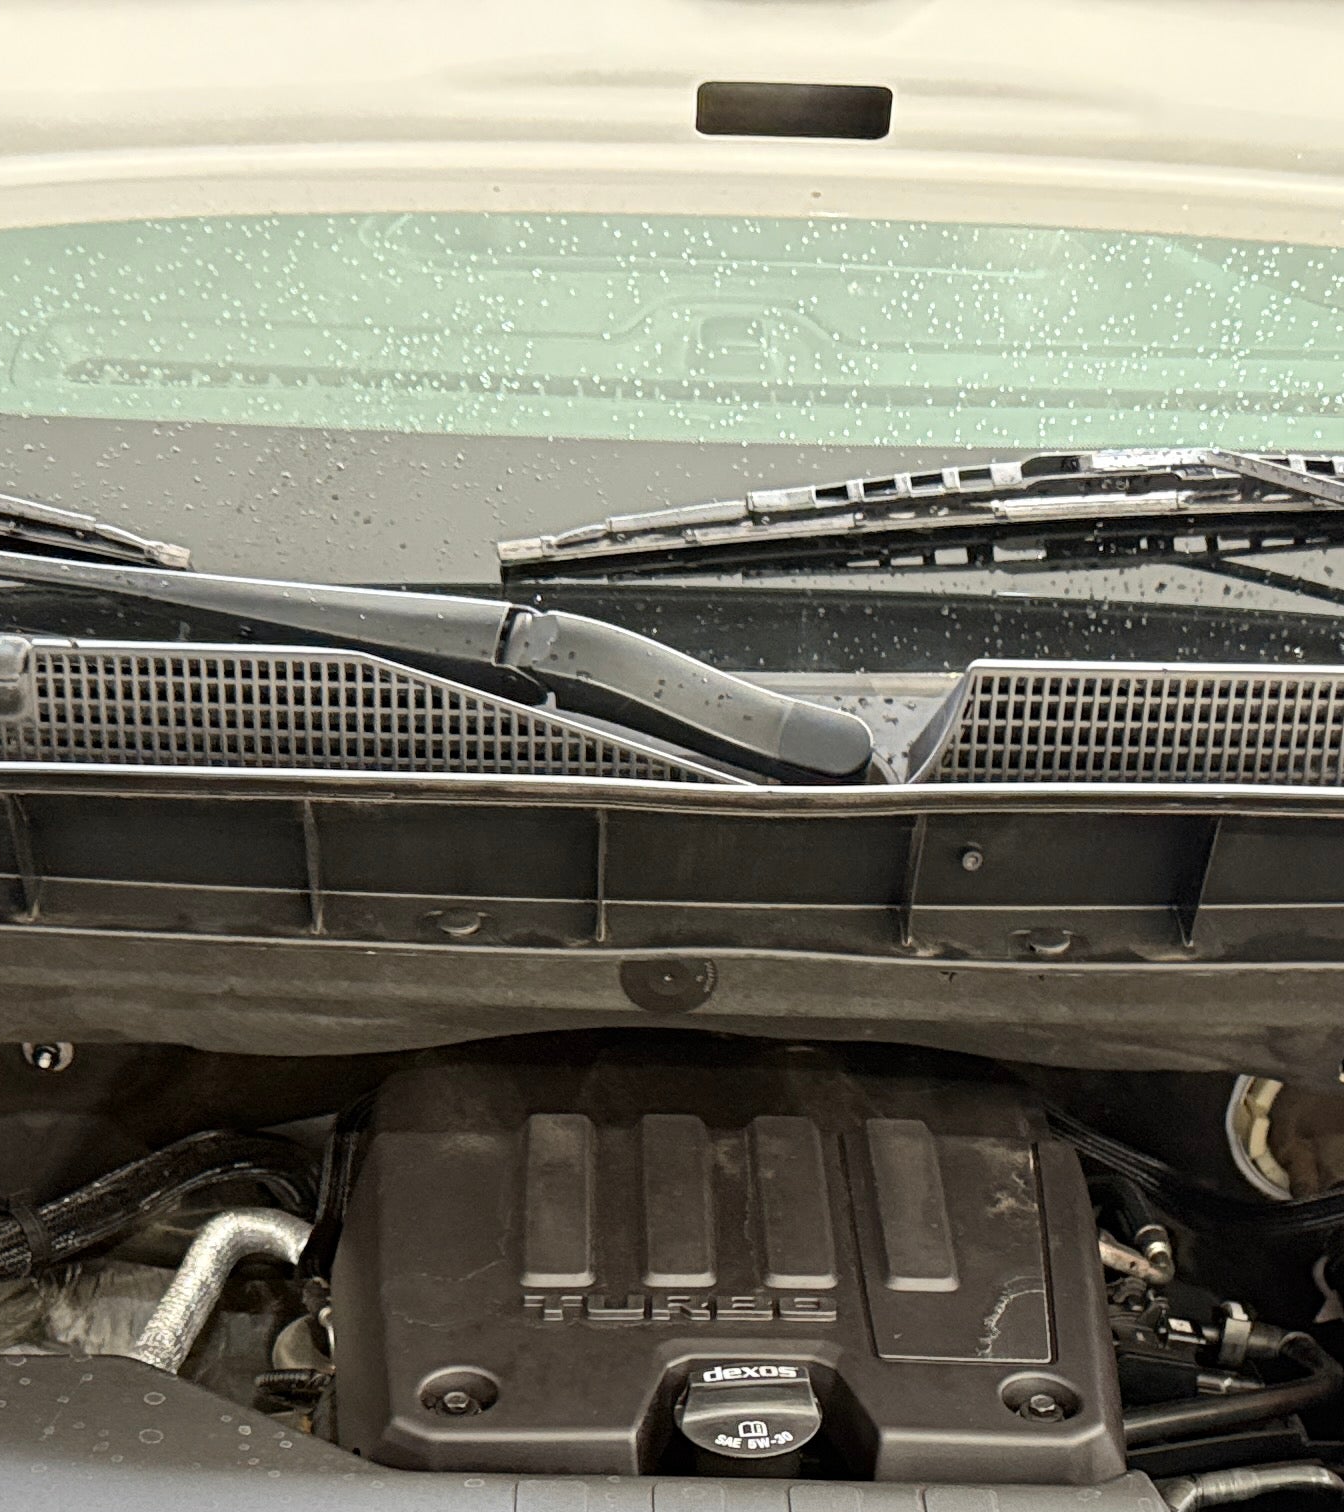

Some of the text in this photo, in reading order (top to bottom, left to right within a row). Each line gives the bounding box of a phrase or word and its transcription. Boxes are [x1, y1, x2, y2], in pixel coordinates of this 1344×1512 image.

[524, 1295, 837, 1321] TURBO
[703, 1366, 797, 1383] dexos
[715, 1431, 794, 1449] SAE 5W-30
